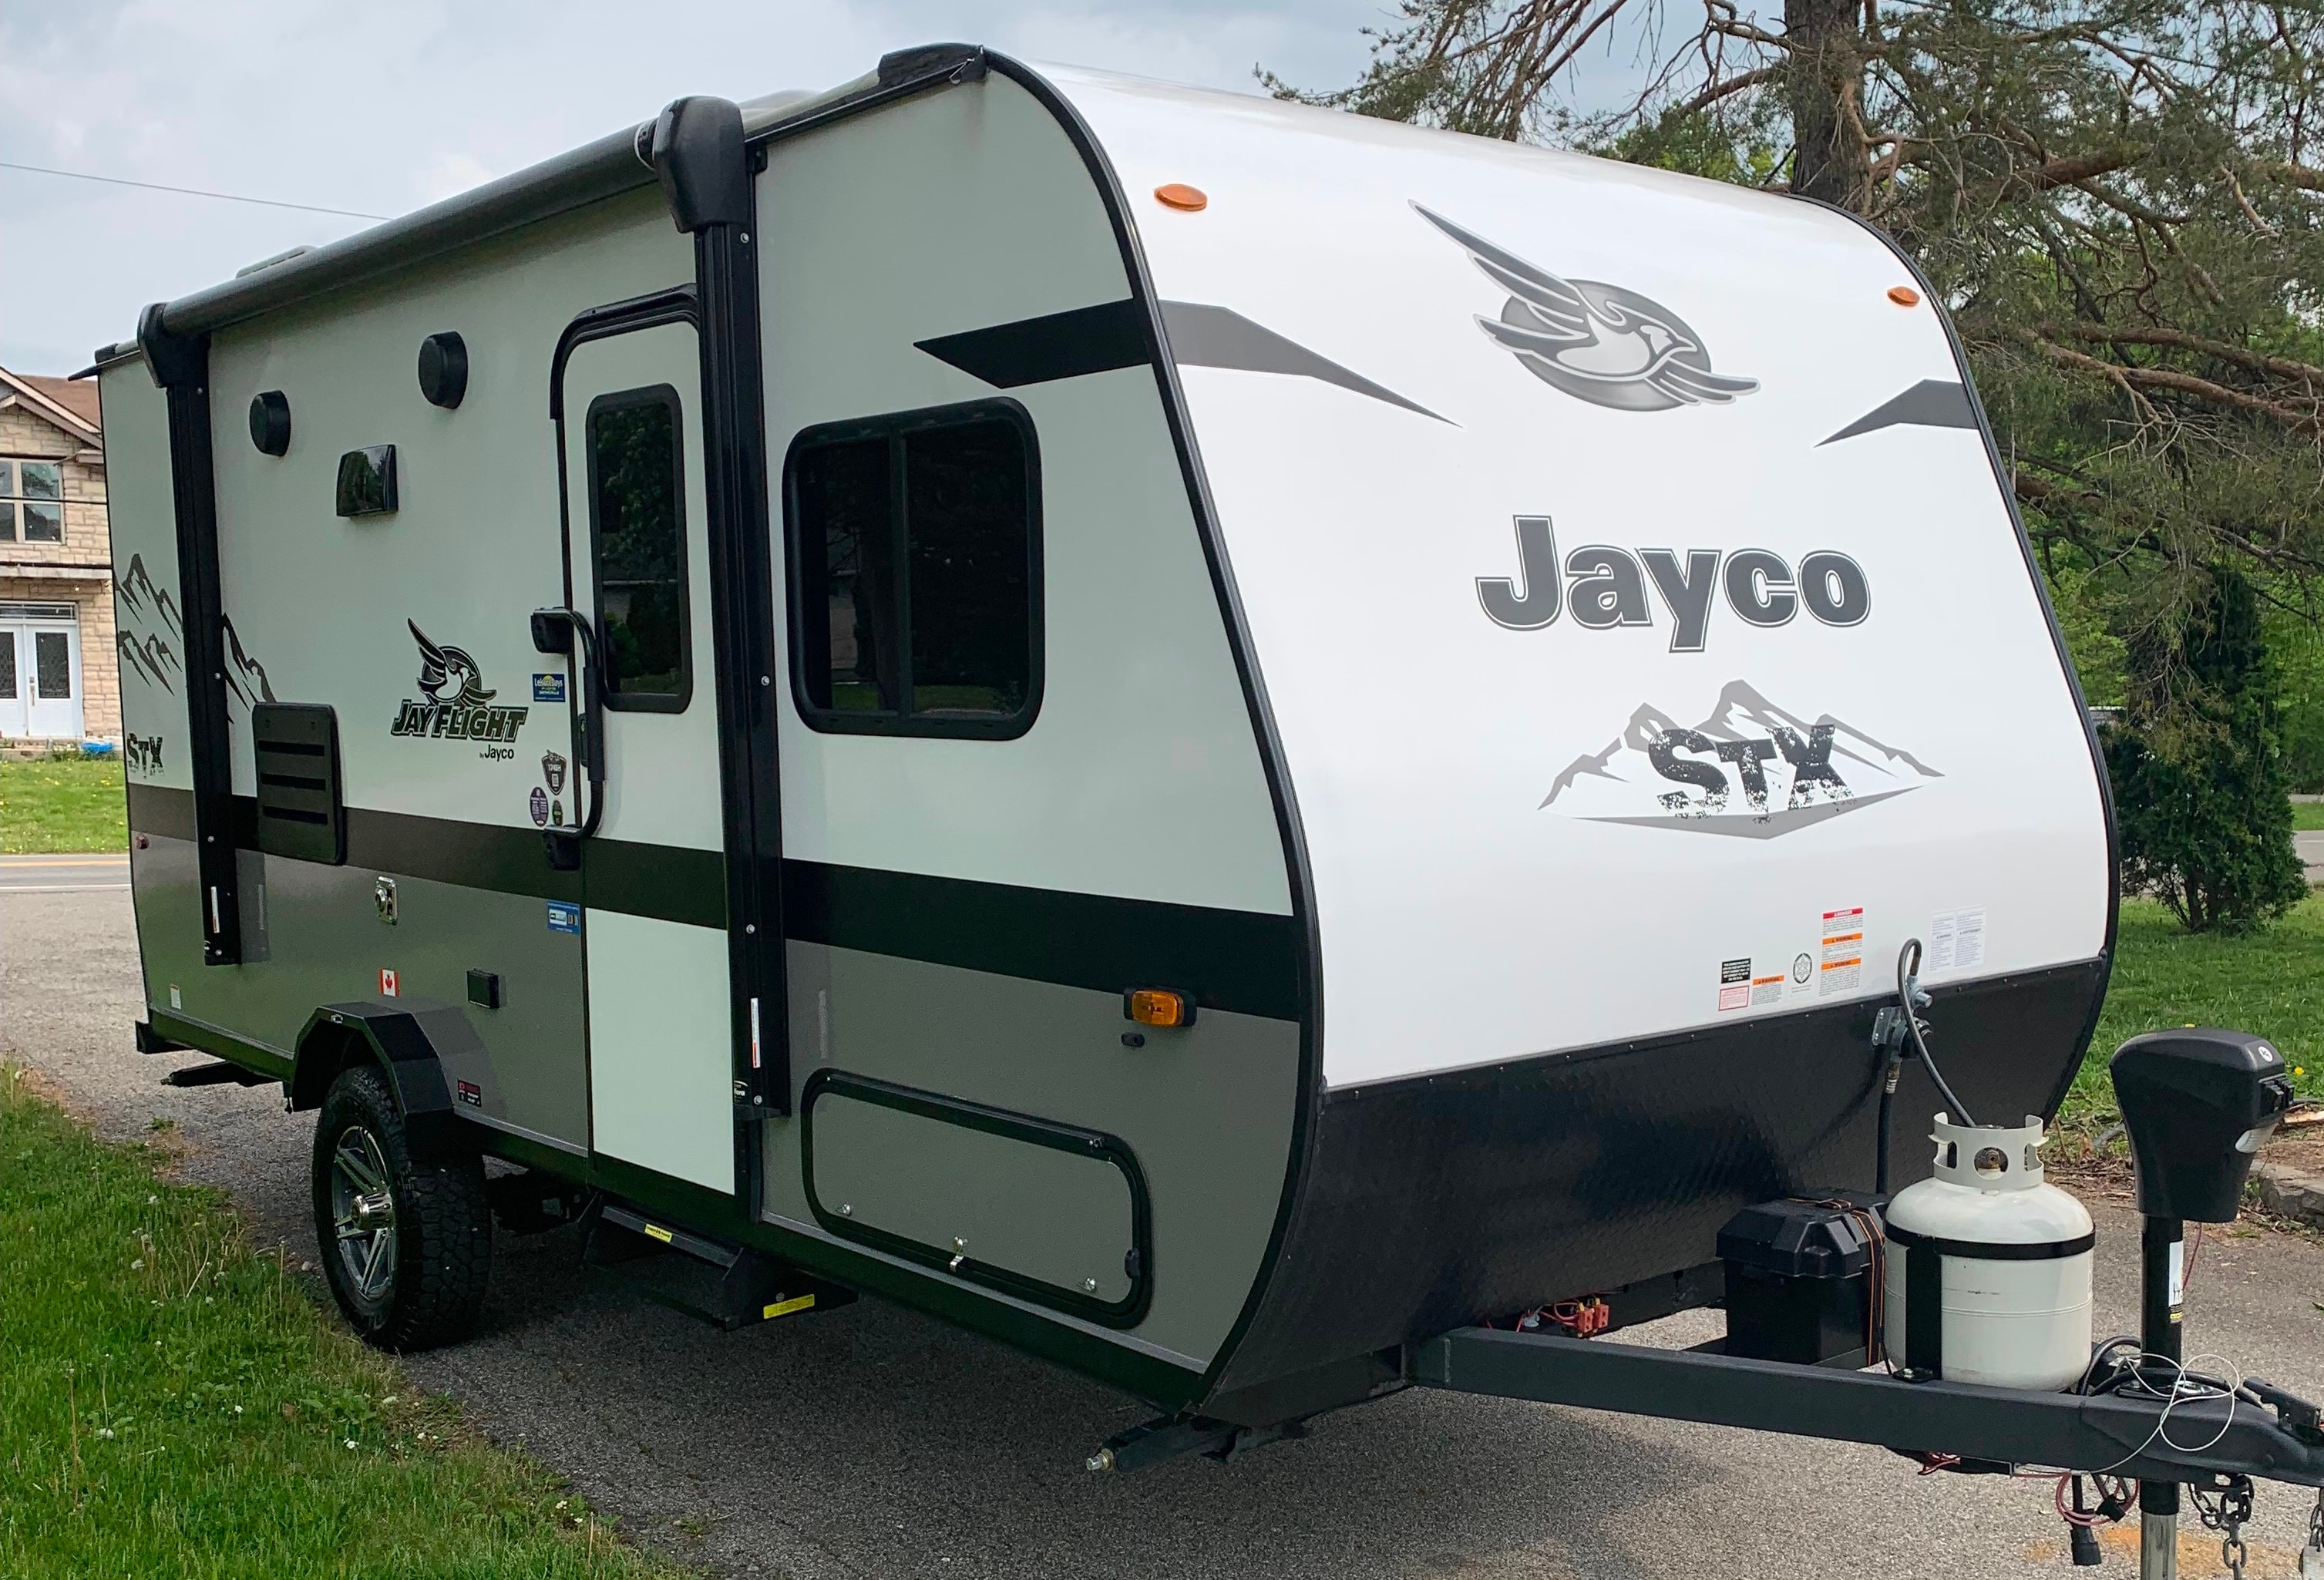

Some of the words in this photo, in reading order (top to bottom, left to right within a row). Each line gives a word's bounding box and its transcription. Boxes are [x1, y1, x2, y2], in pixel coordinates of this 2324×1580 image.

[1475, 514, 1872, 654] Jayco
[390, 698, 438, 737] JAY
[431, 701, 529, 743] FLIGHT
[126, 733, 166, 778] STX
[485, 745, 515, 761] Jayco
[1646, 723, 1856, 825] STX
